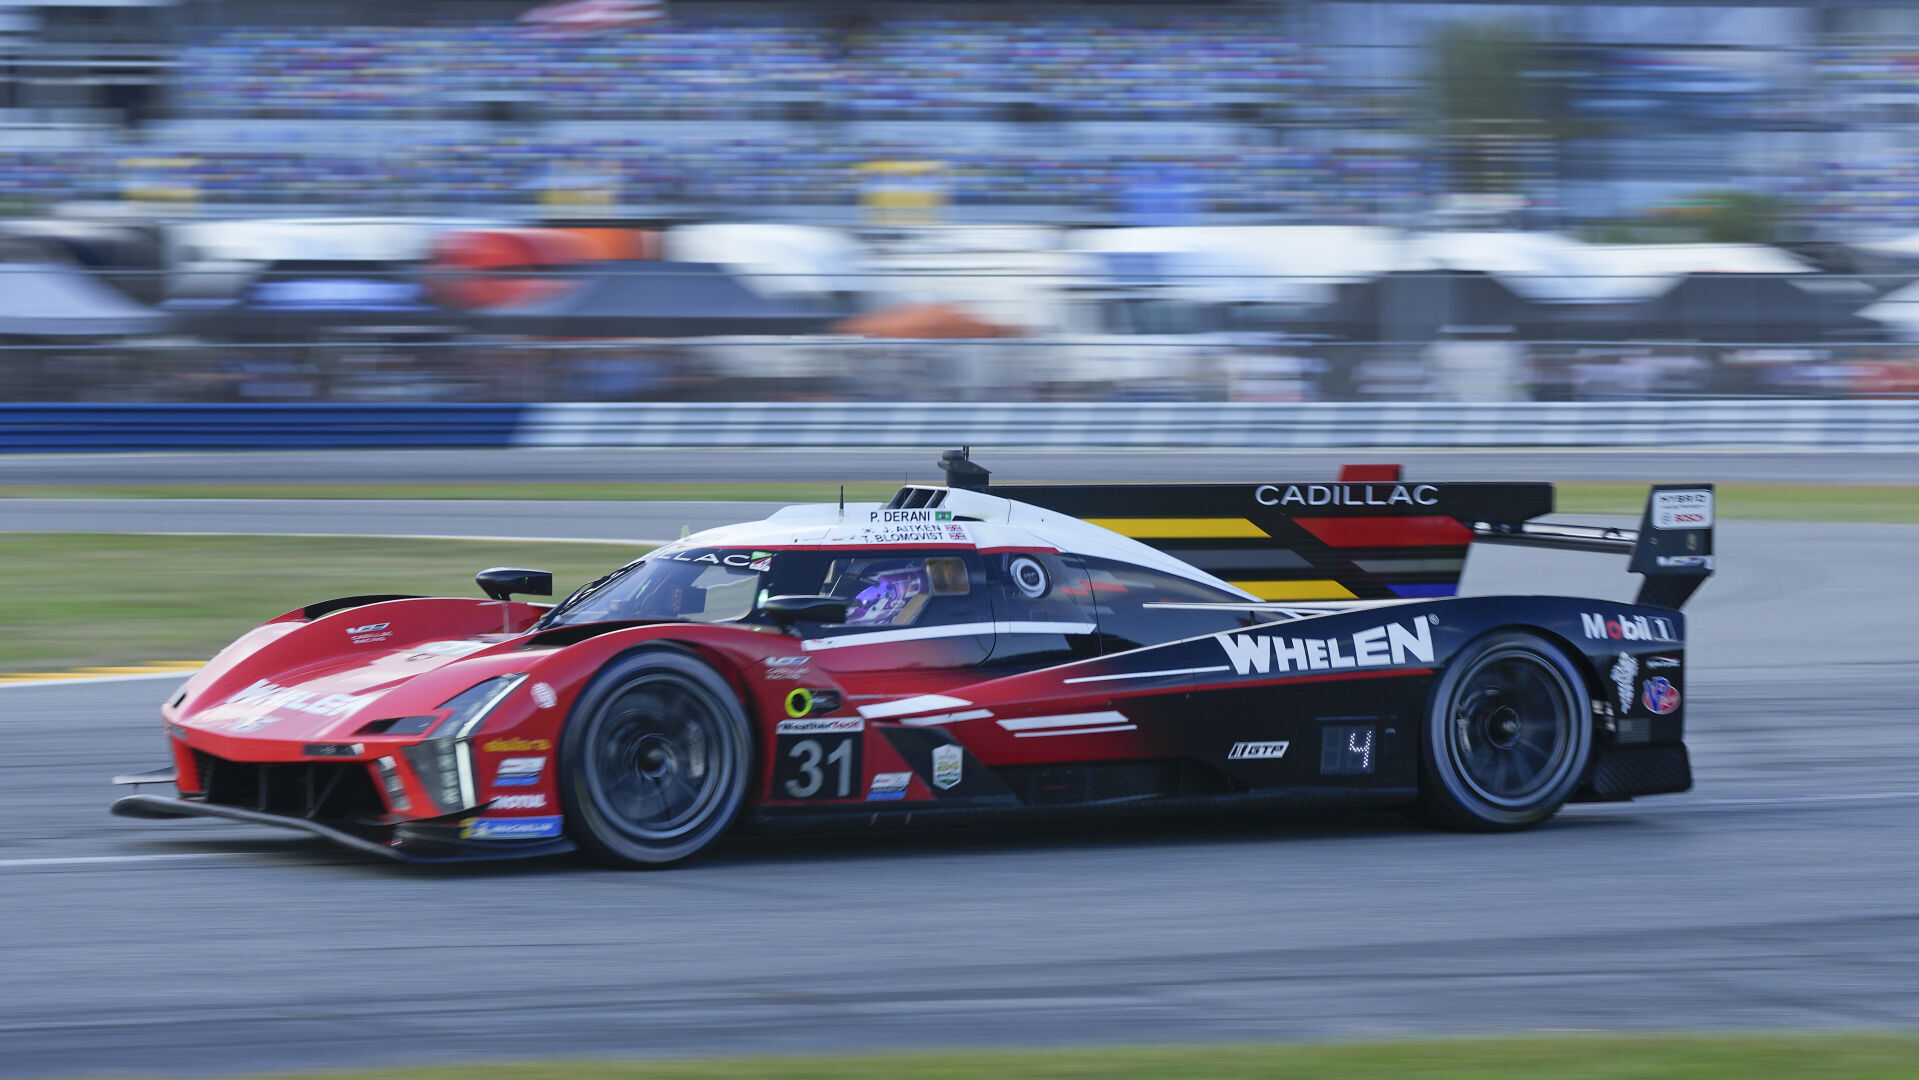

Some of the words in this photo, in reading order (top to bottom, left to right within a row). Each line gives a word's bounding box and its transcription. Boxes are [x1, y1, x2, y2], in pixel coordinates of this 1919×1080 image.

[1255, 484, 1440, 506] CADILLAC
[870, 511, 880, 522] P.
[884, 511, 930, 522] DERANI
[875, 532, 944, 543] BLOMQVIST
[896, 524, 942, 533] AITKEN
[1580, 612, 1653, 641] Mobil
[1214, 615, 1435, 676] WHELEN
[1249, 744, 1284, 755] GTP
[1349, 730, 1372, 768] 4
[784, 738, 854, 798] 31
